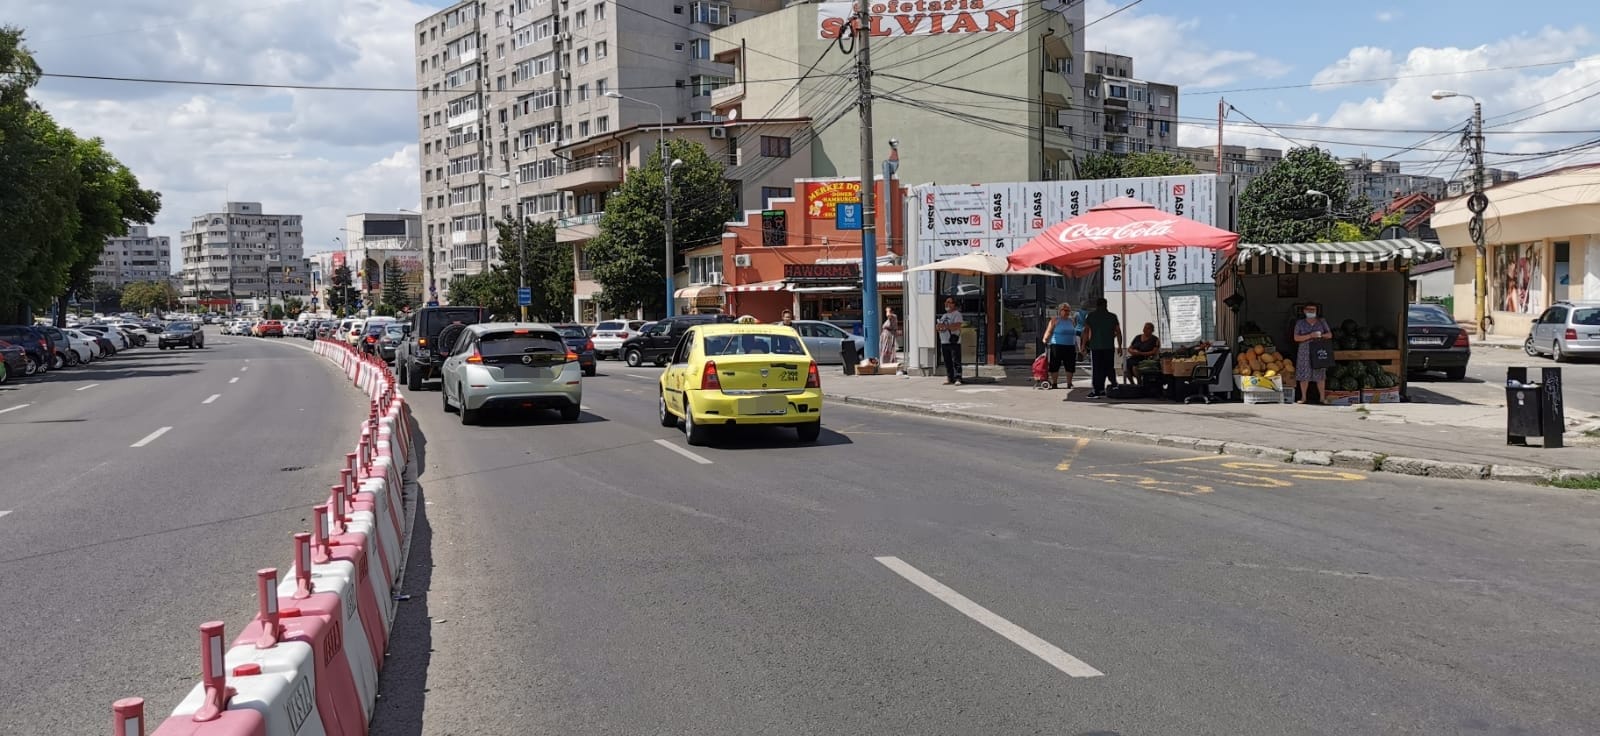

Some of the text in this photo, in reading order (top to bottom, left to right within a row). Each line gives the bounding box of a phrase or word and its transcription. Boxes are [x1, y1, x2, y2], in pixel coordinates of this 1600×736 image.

[808, 183, 844, 201] MERKEZ
[1071, 190, 1079, 216] ASAS
[994, 193, 1002, 218] ASAS
[1033, 192, 1042, 217] ASAS
[1175, 197, 1184, 216] ASA
[945, 216, 969, 225] ASAS
[1059, 218, 1178, 242] Coca-Cola
[1167, 254, 1176, 280] ASAS
